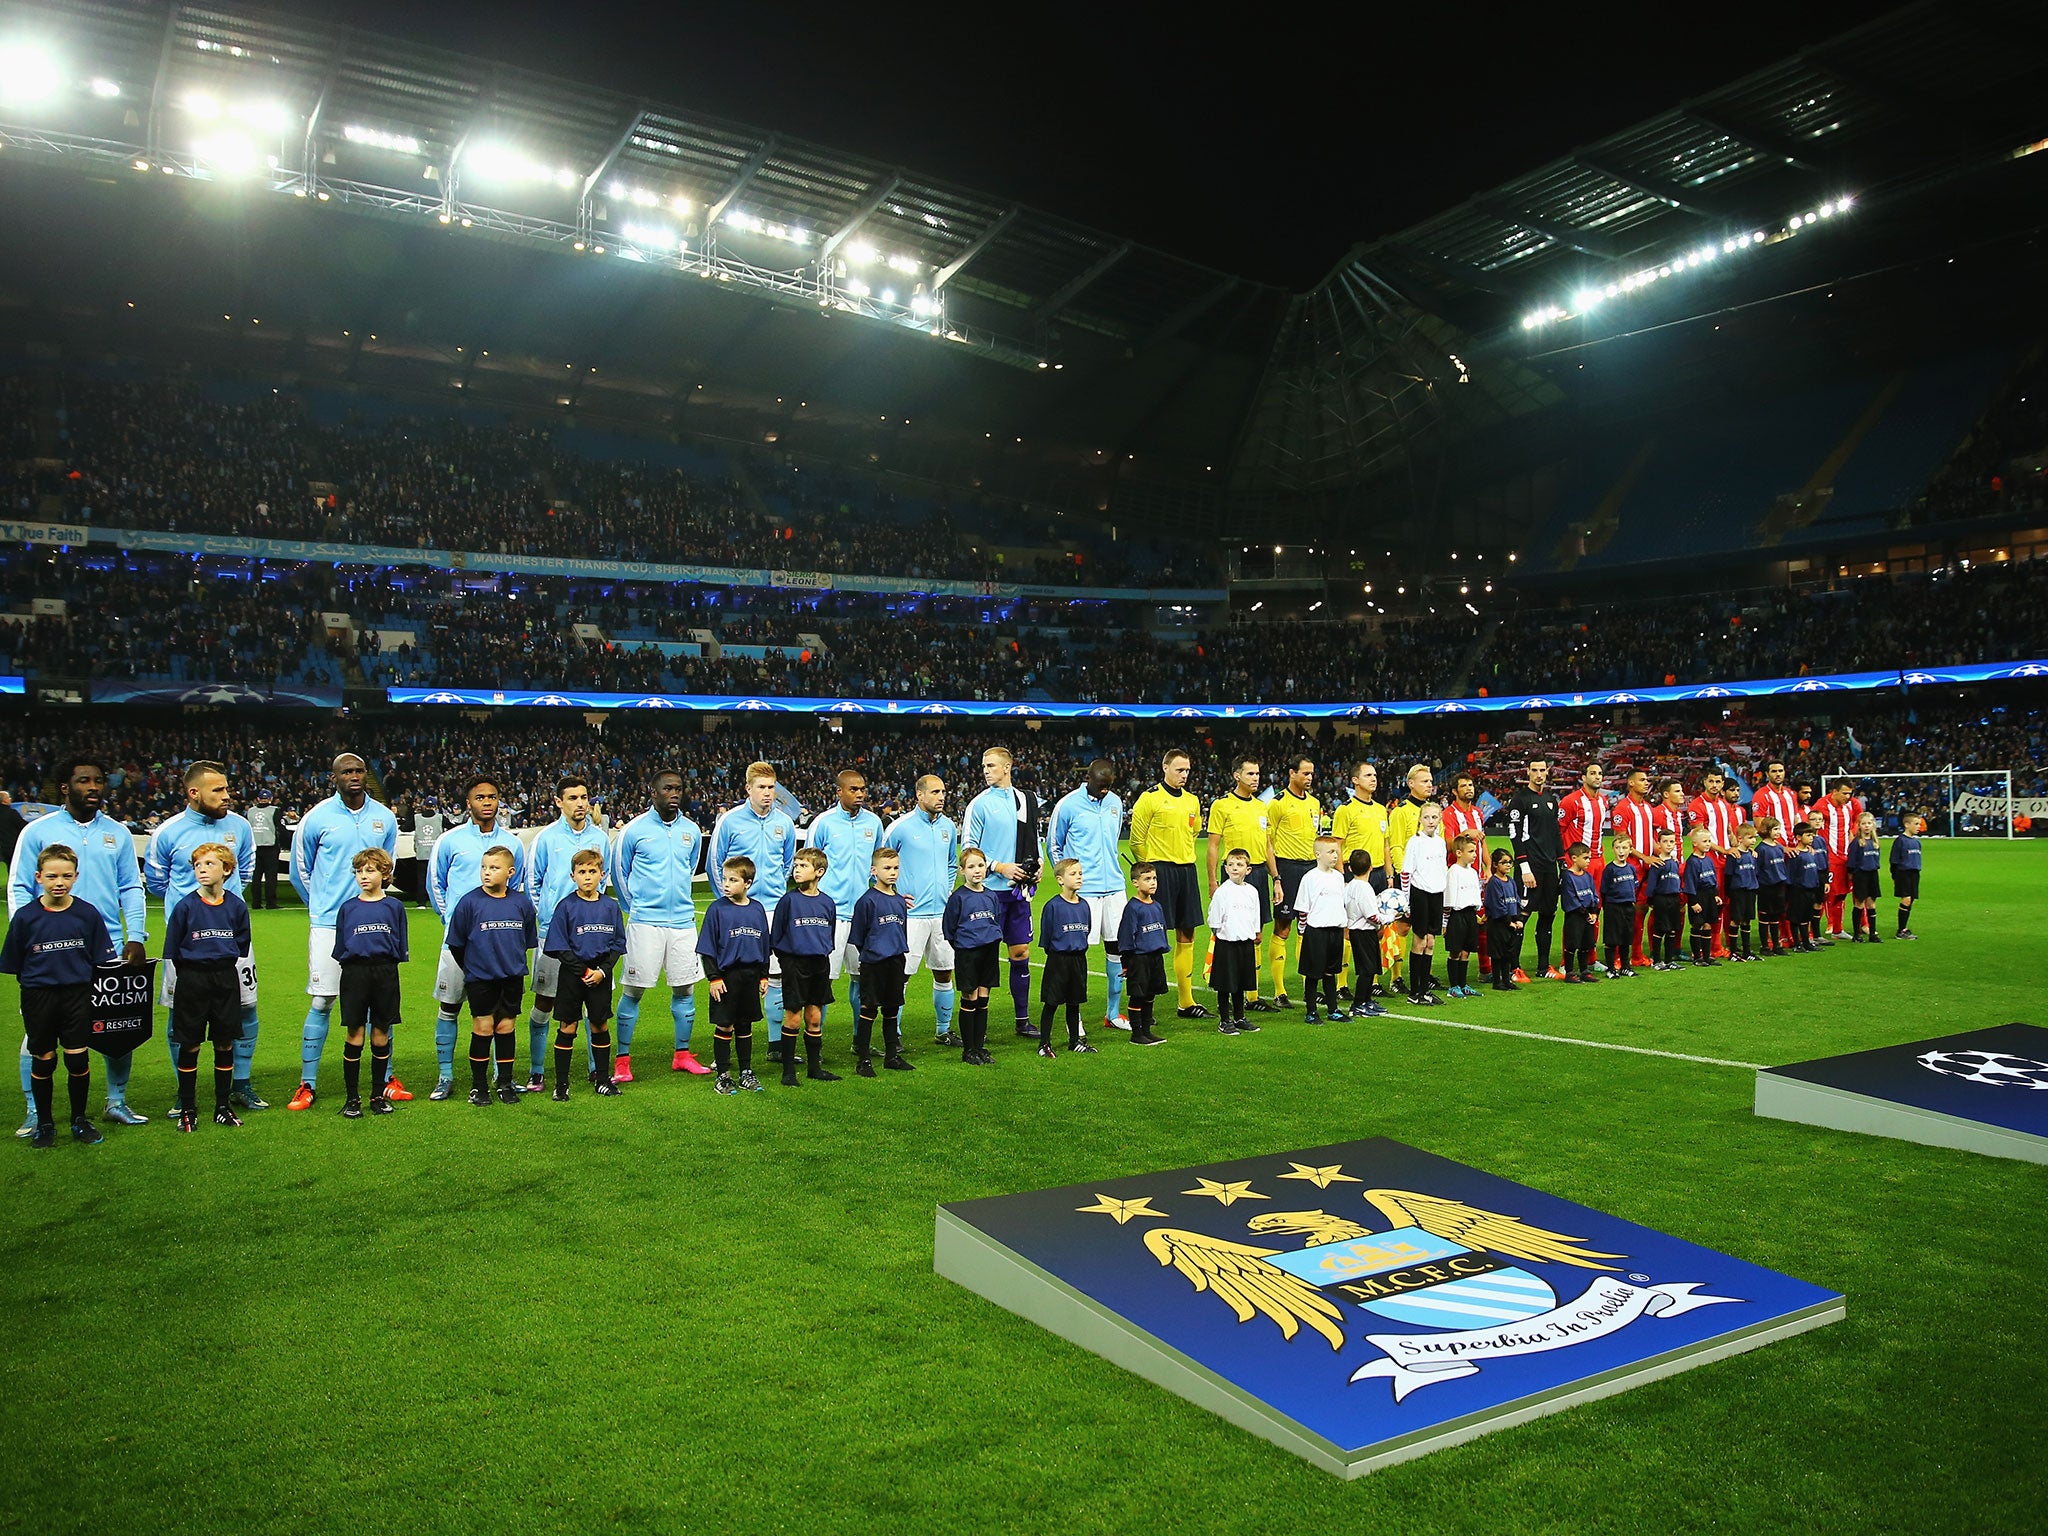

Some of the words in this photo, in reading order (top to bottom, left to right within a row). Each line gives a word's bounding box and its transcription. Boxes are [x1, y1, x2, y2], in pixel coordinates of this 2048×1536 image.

[0, 523, 14, 537] Y
[17, 524, 44, 539] True
[48, 527, 83, 542] Faith
[473, 553, 564, 568] MANCHESTER
[568, 559, 618, 571] THANKS
[655, 565, 699, 576] SHEIKH
[702, 567, 761, 579] MANSOUR
[786, 570, 817, 578] SIERRA
[786, 578, 817, 586] LEONE
[837, 574, 853, 582] The
[854, 576, 876, 584] ONLY
[878, 577, 908, 585] football
[1965, 796, 2021, 813] COME
[93, 976, 119, 993] NO
[123, 974, 148, 990] TO
[91, 991, 148, 1007] RACISM
[106, 1018, 143, 1030] RESPECT
[1338, 1257, 1494, 1300] M.C.F.C.
[1398, 1330, 1551, 1356] Superbia
[1545, 1322, 1588, 1337] In
